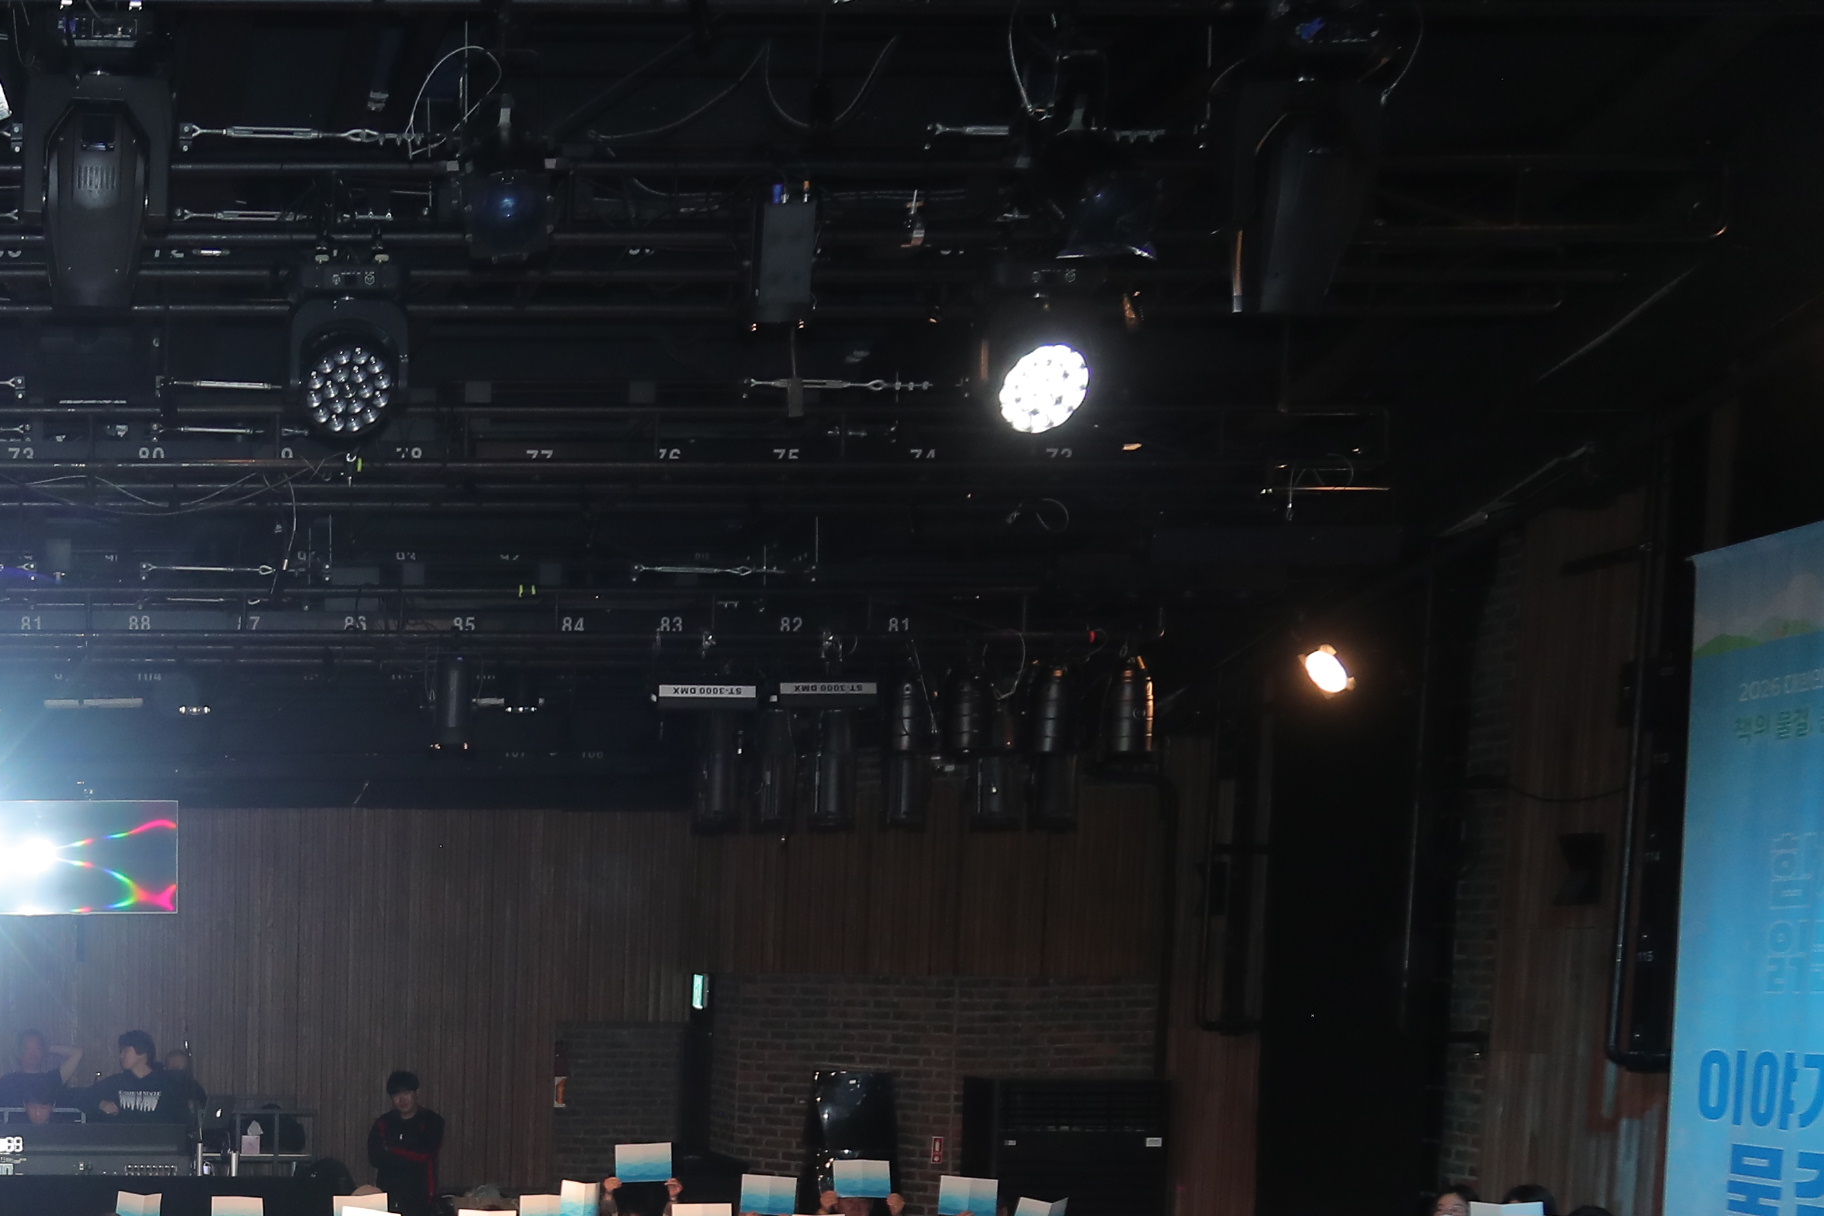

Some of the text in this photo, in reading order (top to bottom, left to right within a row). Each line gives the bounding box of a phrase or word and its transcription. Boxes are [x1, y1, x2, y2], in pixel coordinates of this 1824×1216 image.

[21, 616, 42, 630] 81
[128, 616, 150, 630] 88
[561, 616, 585, 631] 84
[660, 616, 683, 632] 83
[780, 616, 803, 632] 82
[888, 616, 910, 632] 81
[1738, 677, 1781, 703] 2026
